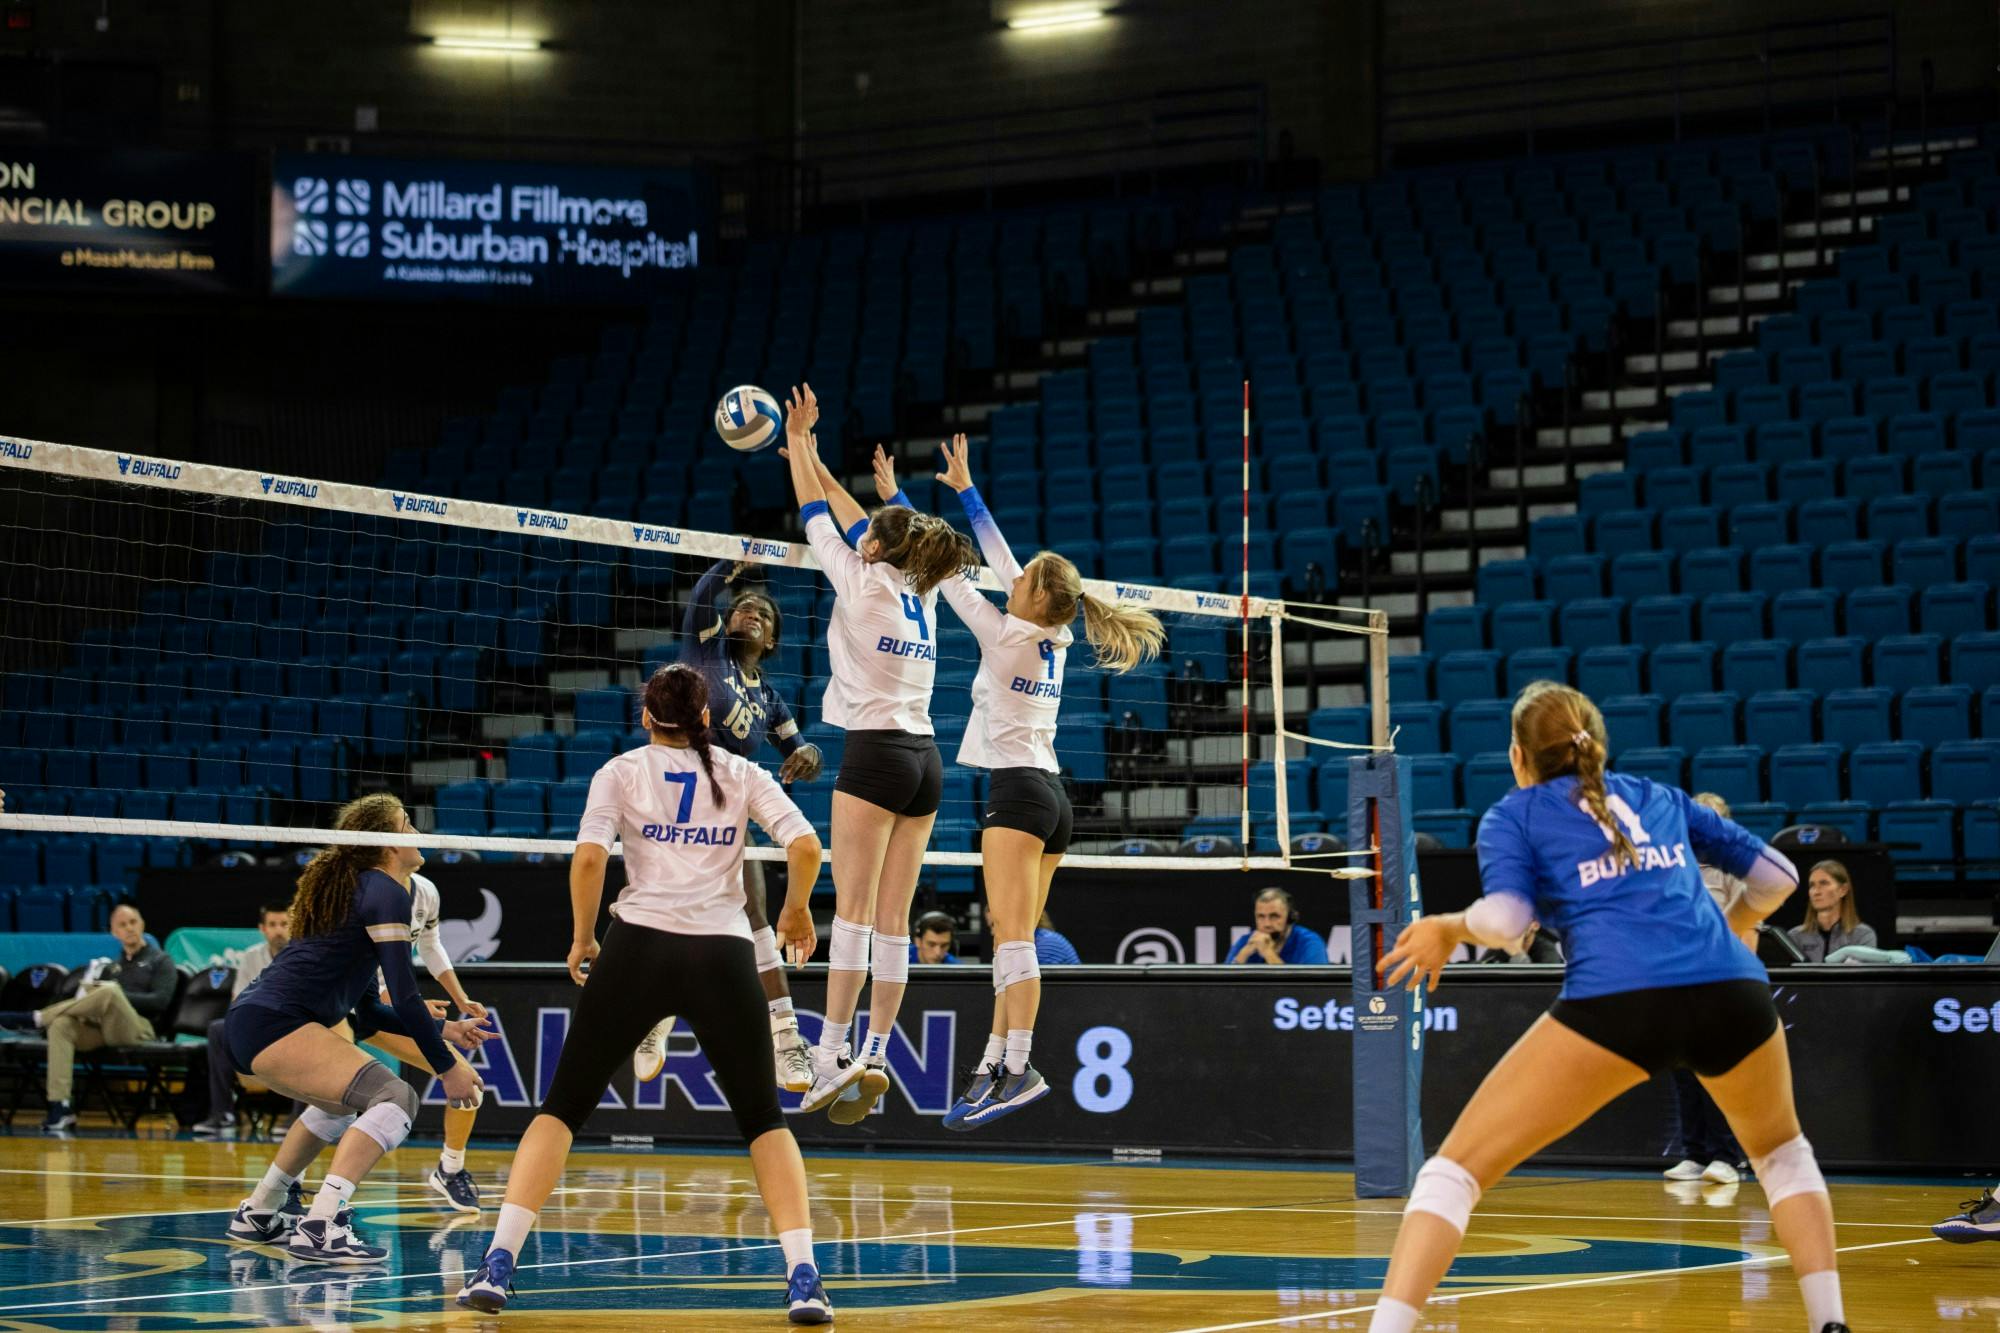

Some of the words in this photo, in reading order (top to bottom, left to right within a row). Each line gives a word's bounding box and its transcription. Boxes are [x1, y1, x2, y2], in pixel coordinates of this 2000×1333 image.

[0, 197, 91, 226] NCIAL
[102, 200, 216, 229] GROUP
[383, 180, 502, 221] Millard
[511, 185, 648, 226] Fillmore
[381, 221, 548, 263] Suburban
[557, 228, 698, 278] Hospital
[132, 460, 181, 480] BUFFALO
[274, 481, 318, 499] BUFFALO
[405, 498, 448, 516] BUFFALO
[529, 512, 568, 531] BUFFALO
[643, 528, 681, 546] BUFFALO
[752, 542, 788, 558] BUFFALO
[900, 592, 930, 641] 4
[1038, 638, 1057, 680] 9
[664, 771, 698, 824] 7
[641, 823, 738, 847] BUFFALO
[1073, 1025, 1134, 1113] 8
